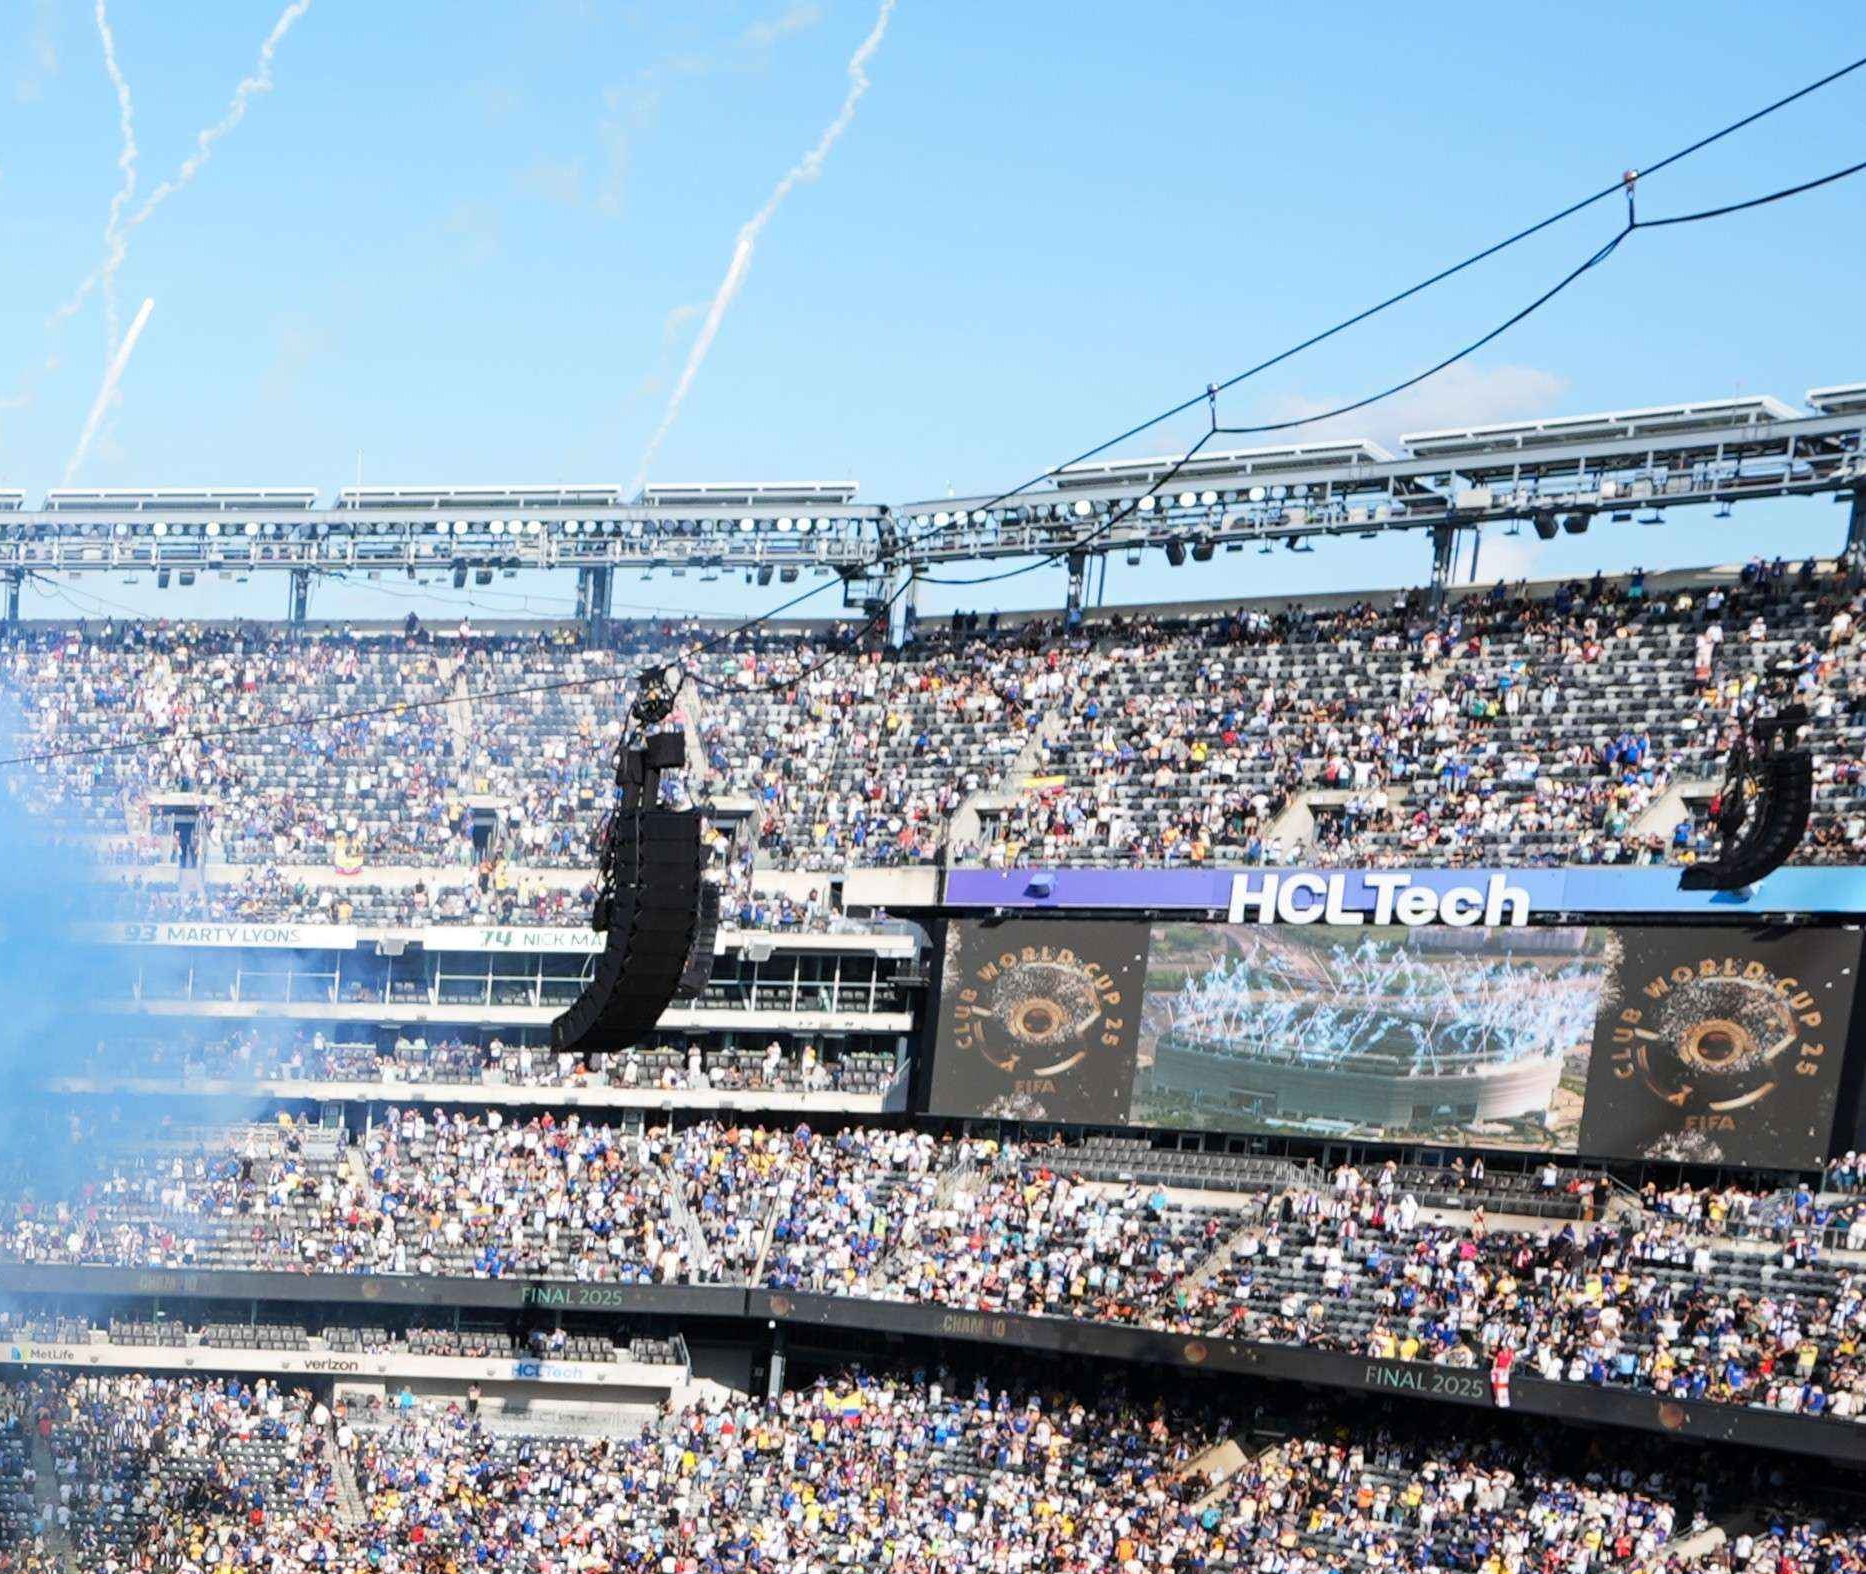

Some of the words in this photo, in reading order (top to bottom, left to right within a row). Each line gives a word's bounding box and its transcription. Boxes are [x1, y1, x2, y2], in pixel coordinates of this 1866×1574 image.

[1228, 872, 1531, 927] HCLTech
[124, 924, 158, 942] 93
[167, 927, 238, 944] MARTY
[242, 929, 301, 945] LYONS
[478, 930, 514, 946] 74
[522, 933, 565, 948] NICK
[976, 945, 1075, 983] WORLD
[1643, 957, 1766, 999] WORLD
[1083, 963, 1122, 1005] CUP
[1774, 976, 1823, 1028] CUP
[954, 988, 978, 1049] CLUB
[1100, 1017, 1124, 1047] 25
[1611, 1007, 1643, 1079] CLUB
[1795, 1042, 1825, 1076] 25
[1014, 1079, 1057, 1094] FIFA
[1685, 1115, 1736, 1131] FIFA
[521, 1286, 573, 1306] FINAL
[579, 1289, 623, 1306] 2025
[29, 1349, 75, 1361] MetLife
[304, 1358, 359, 1372] verizon
[511, 1363, 584, 1380] HCLTech
[1365, 1364, 1428, 1393] FINAL
[1431, 1374, 1484, 1399] 2025
